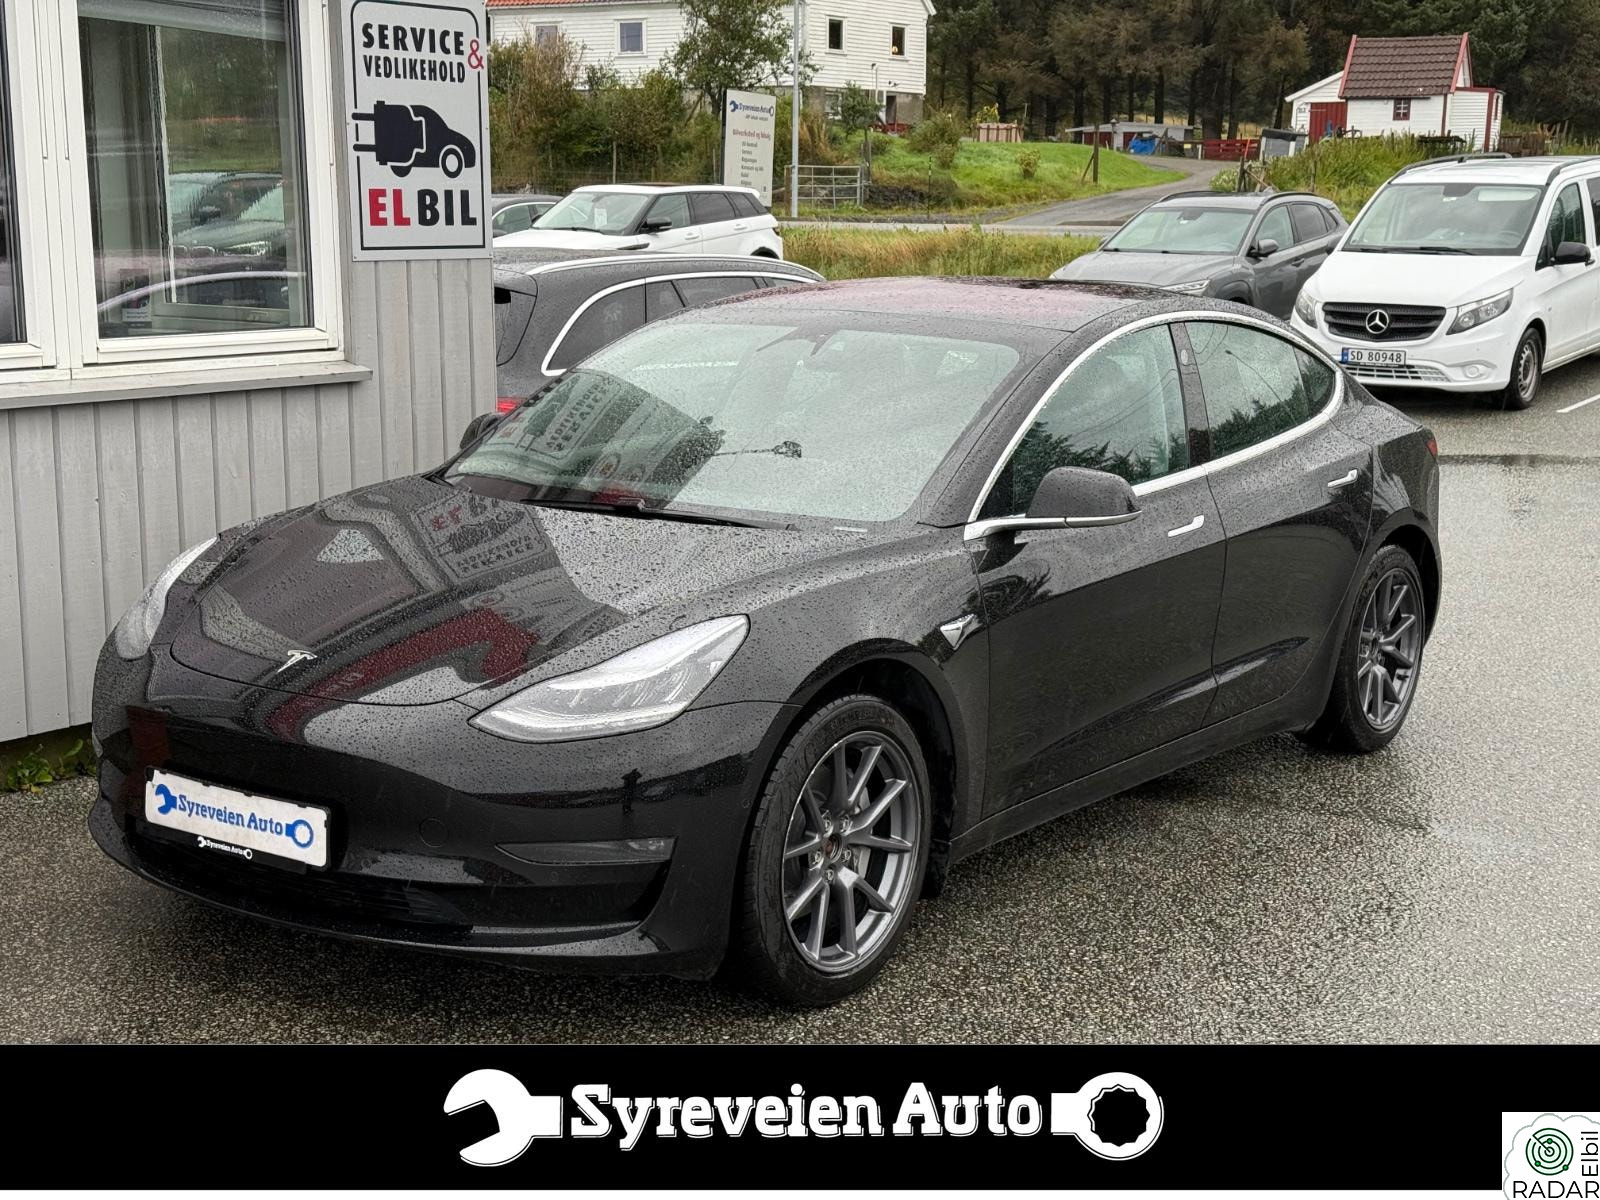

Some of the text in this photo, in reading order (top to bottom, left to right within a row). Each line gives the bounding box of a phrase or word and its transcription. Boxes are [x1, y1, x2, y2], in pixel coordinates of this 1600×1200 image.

[362, 22, 484, 70] SERVICE &
[363, 54, 465, 84] VEDLIKEHOLD
[1350, 350, 1402, 363] SD 80948
[178, 794, 283, 836] Syreveien Auto
[206, 840, 243, 855] Syreveien Auto
